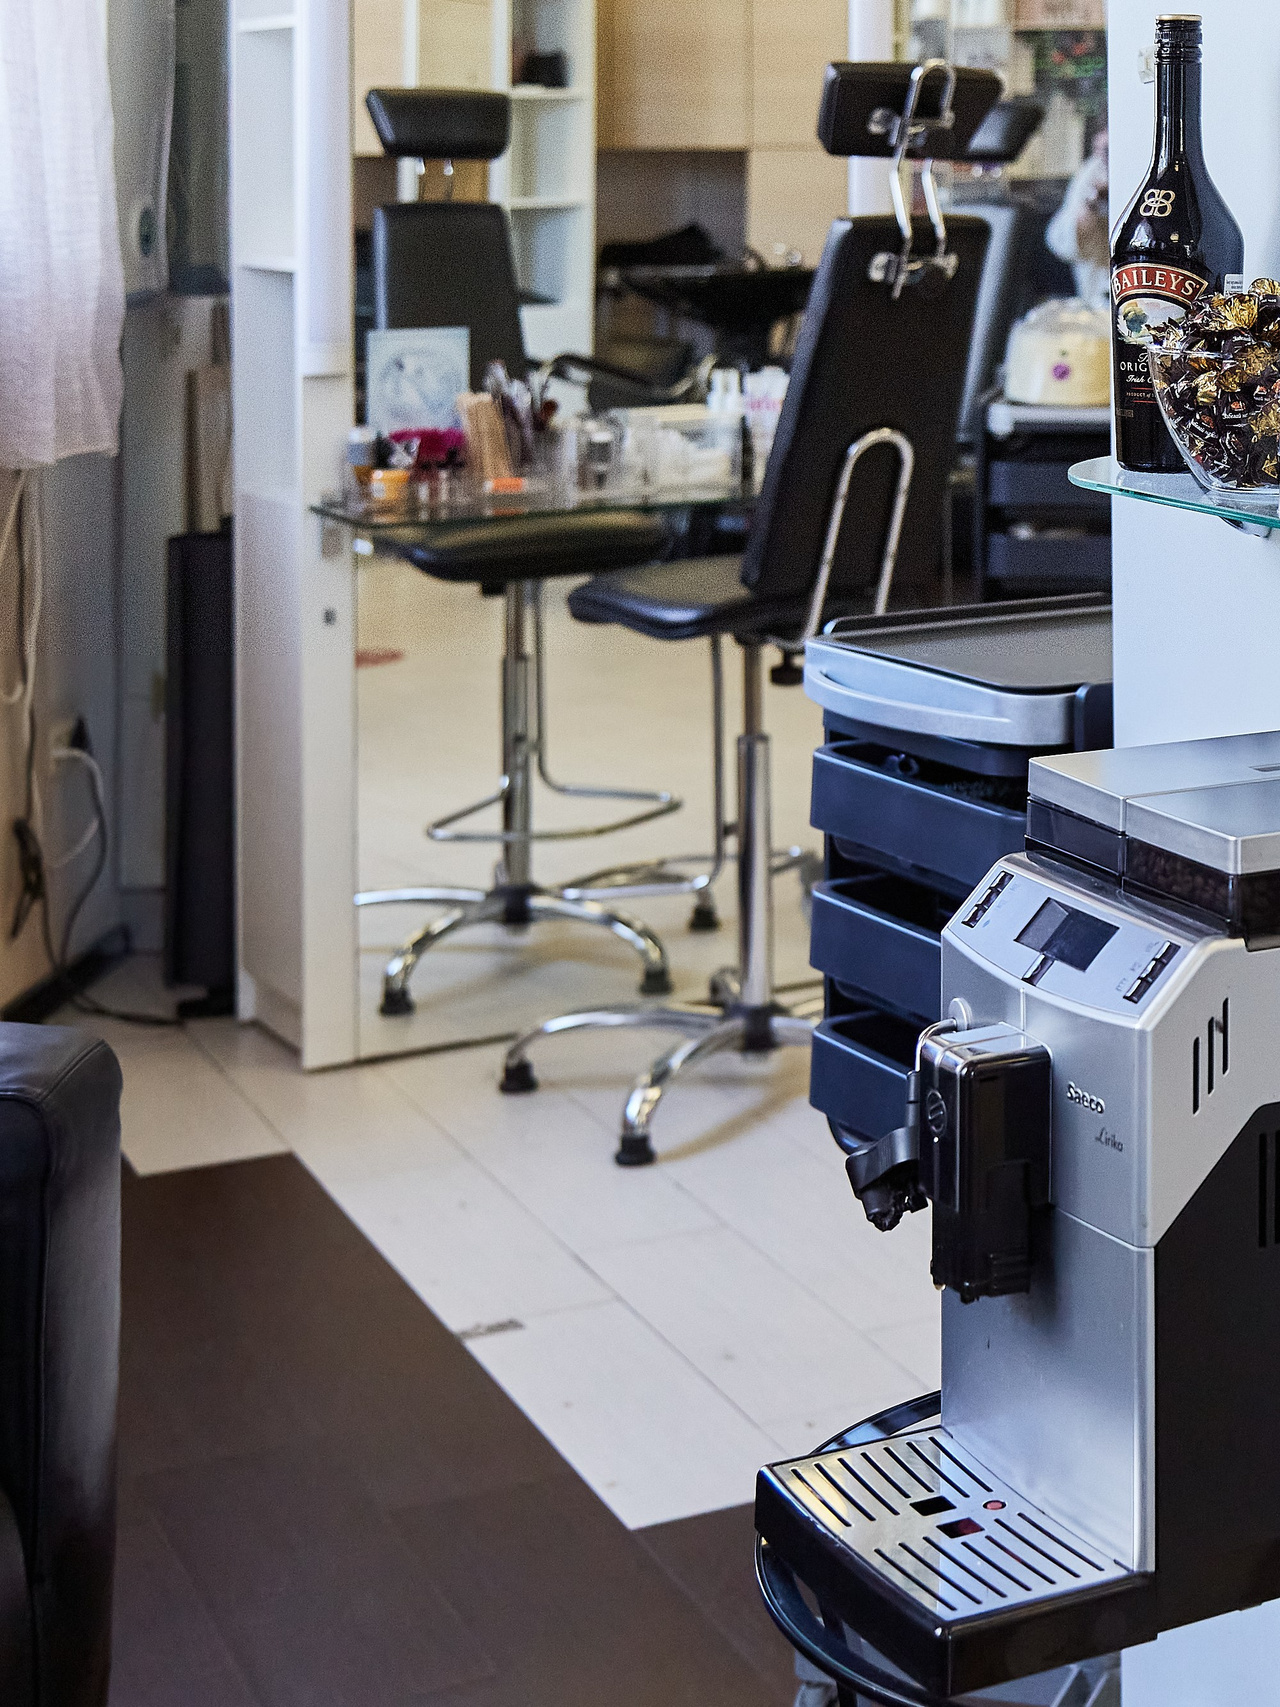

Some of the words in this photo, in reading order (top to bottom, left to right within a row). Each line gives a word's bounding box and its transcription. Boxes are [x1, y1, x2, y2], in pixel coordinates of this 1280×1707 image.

[1112, 269, 1196, 296] BAILEYS
[1119, 361, 1148, 372] ORIG
[1126, 374, 1146, 383] Irish
[1066, 1081, 1105, 1115] Saeco
[1095, 1126, 1124, 1152] Lirika
